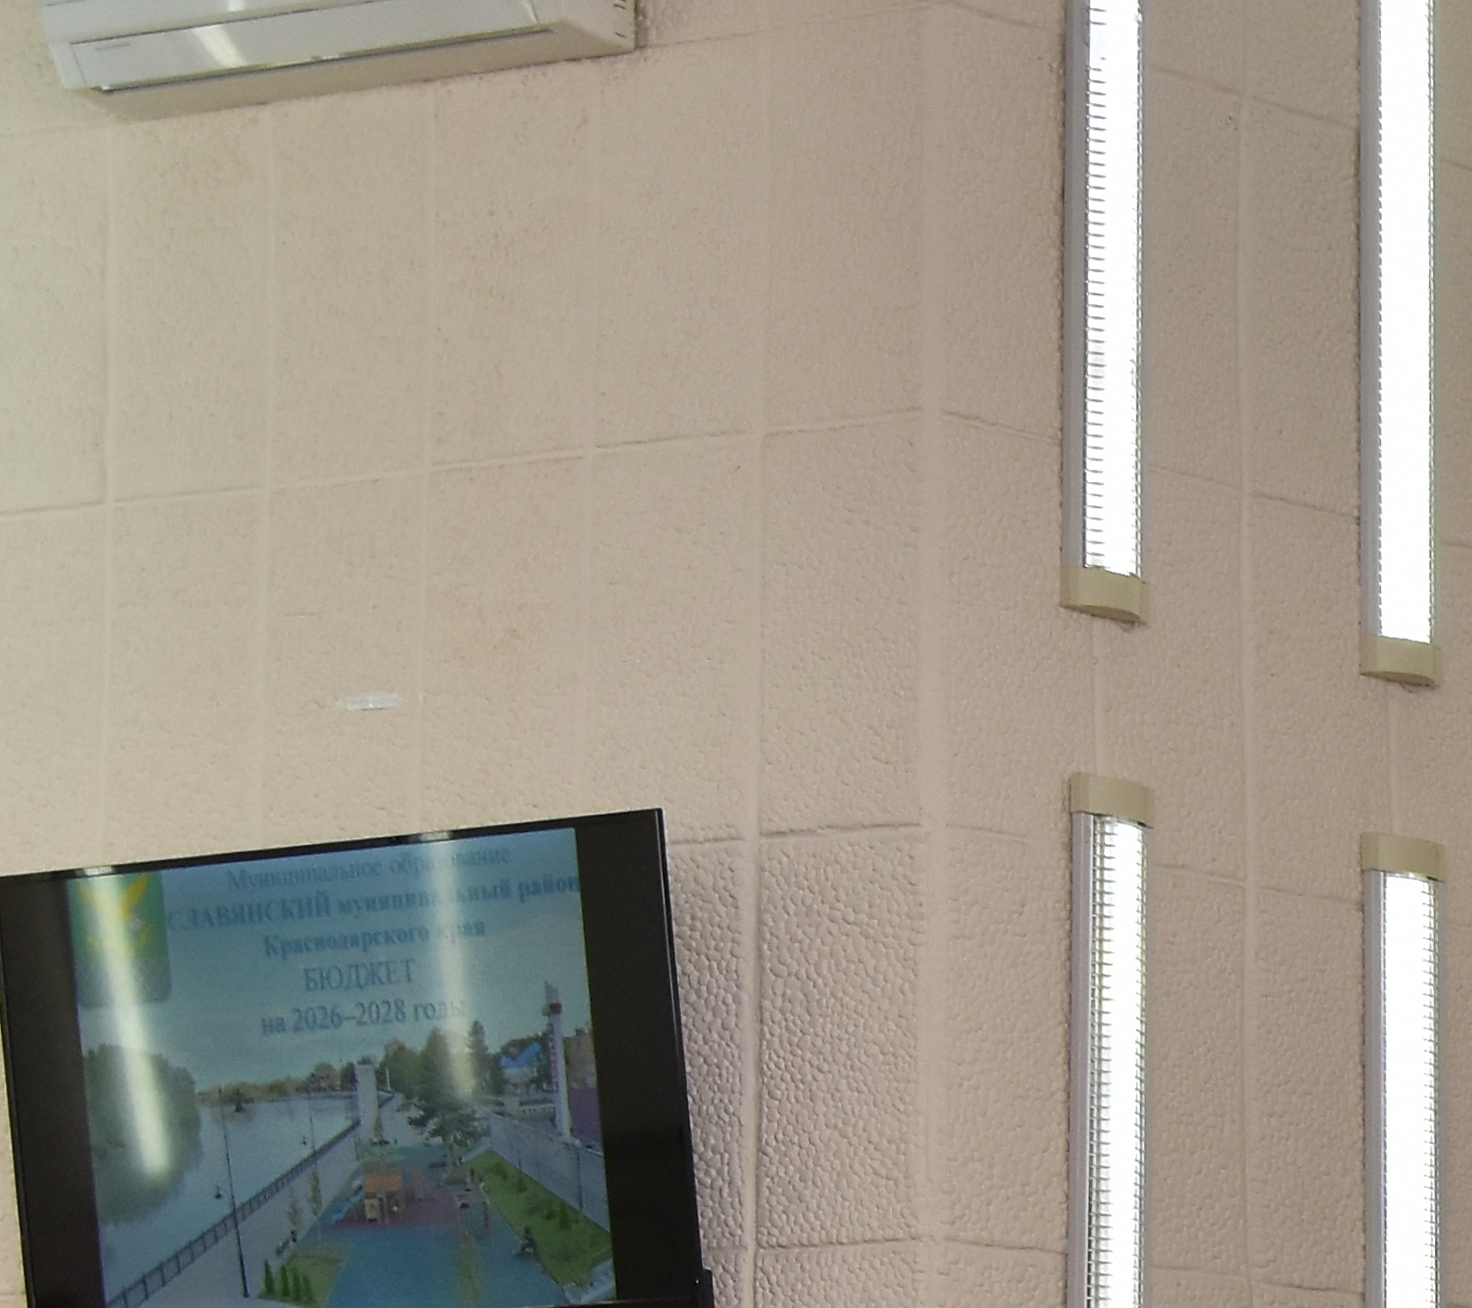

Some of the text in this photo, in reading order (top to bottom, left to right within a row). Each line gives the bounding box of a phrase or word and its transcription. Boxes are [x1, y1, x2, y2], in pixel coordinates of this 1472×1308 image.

[227, 849, 510, 891] Муниципальное обравание
[168, 890, 331, 932] СЛАВЯНСКИЙ
[338, 878, 512, 918] муниципьный
[264, 920, 486, 960] Краснодарского рая
[304, 957, 415, 994] БЮДЖЕТ
[262, 1016, 286, 1035] на
